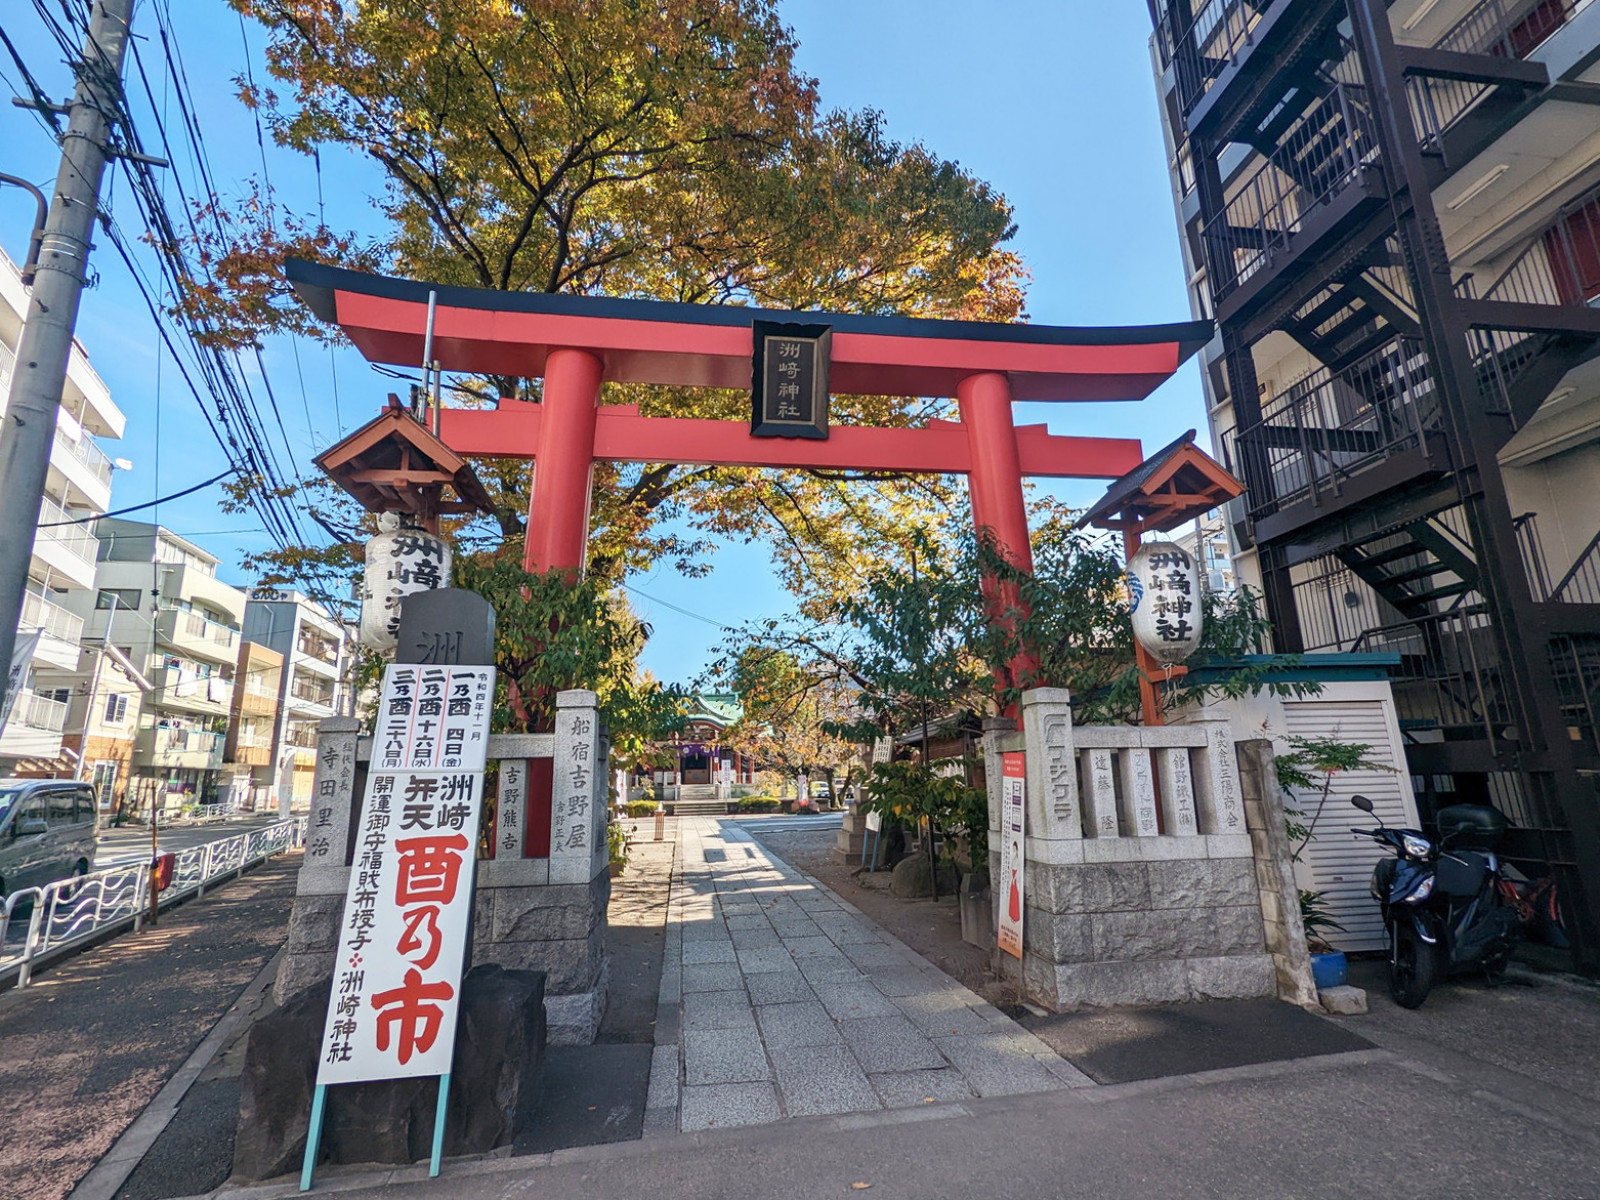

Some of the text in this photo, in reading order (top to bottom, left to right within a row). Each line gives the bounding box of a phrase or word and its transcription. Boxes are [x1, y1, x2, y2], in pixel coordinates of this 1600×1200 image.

[777, 343, 801, 418] 洲崎神社
[1148, 551, 1193, 641] 洲崎神社
[470, 672, 488, 741] 令和四年十一月
[502, 766, 521, 850] 吉野熊吉
[565, 716, 590, 849] 船宿吉野屋
[371, 833, 469, 1066] 酉乃市
[327, 970, 365, 1064] 洲崎神社
